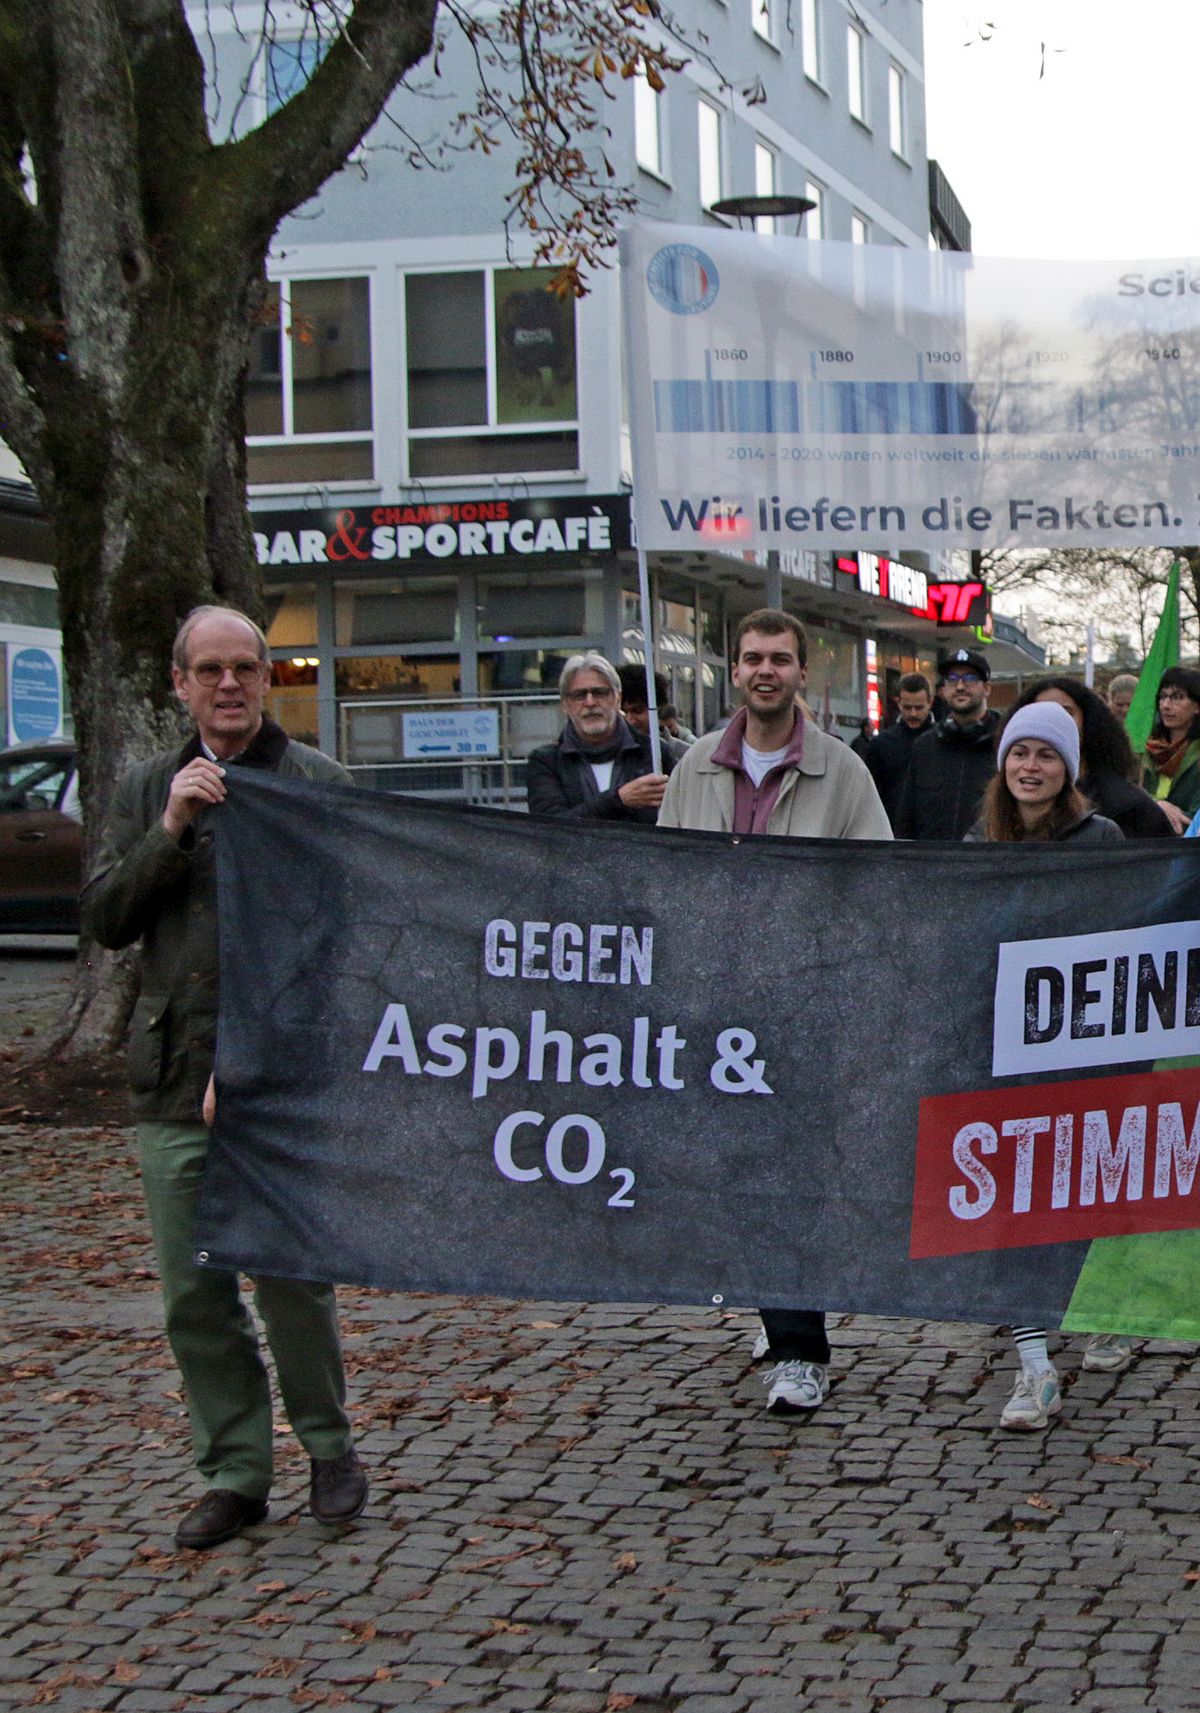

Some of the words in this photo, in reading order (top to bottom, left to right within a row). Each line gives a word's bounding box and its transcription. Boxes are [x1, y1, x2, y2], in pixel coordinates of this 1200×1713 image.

[714, 348, 748, 361] 1860
[819, 350, 855, 363] 1880
[926, 350, 962, 363] 1900
[727, 446, 765, 461] 2014
[781, 446, 823, 461] 2020
[828, 449, 882, 461] waren
[888, 447, 965, 461] weltweit
[370, 502, 509, 525] CHAMPIONS
[660, 496, 743, 531] Wir
[758, 495, 906, 532] liefern
[921, 496, 993, 532] die
[1009, 497, 1183, 531] Fakten.
[253, 528, 329, 565] BAR
[325, 508, 370, 562] &
[371, 505, 612, 561] SPORTCAFÈ
[484, 918, 654, 986] GEGEN
[362, 1003, 687, 1099] Asphalt
[709, 1026, 775, 1095] &
